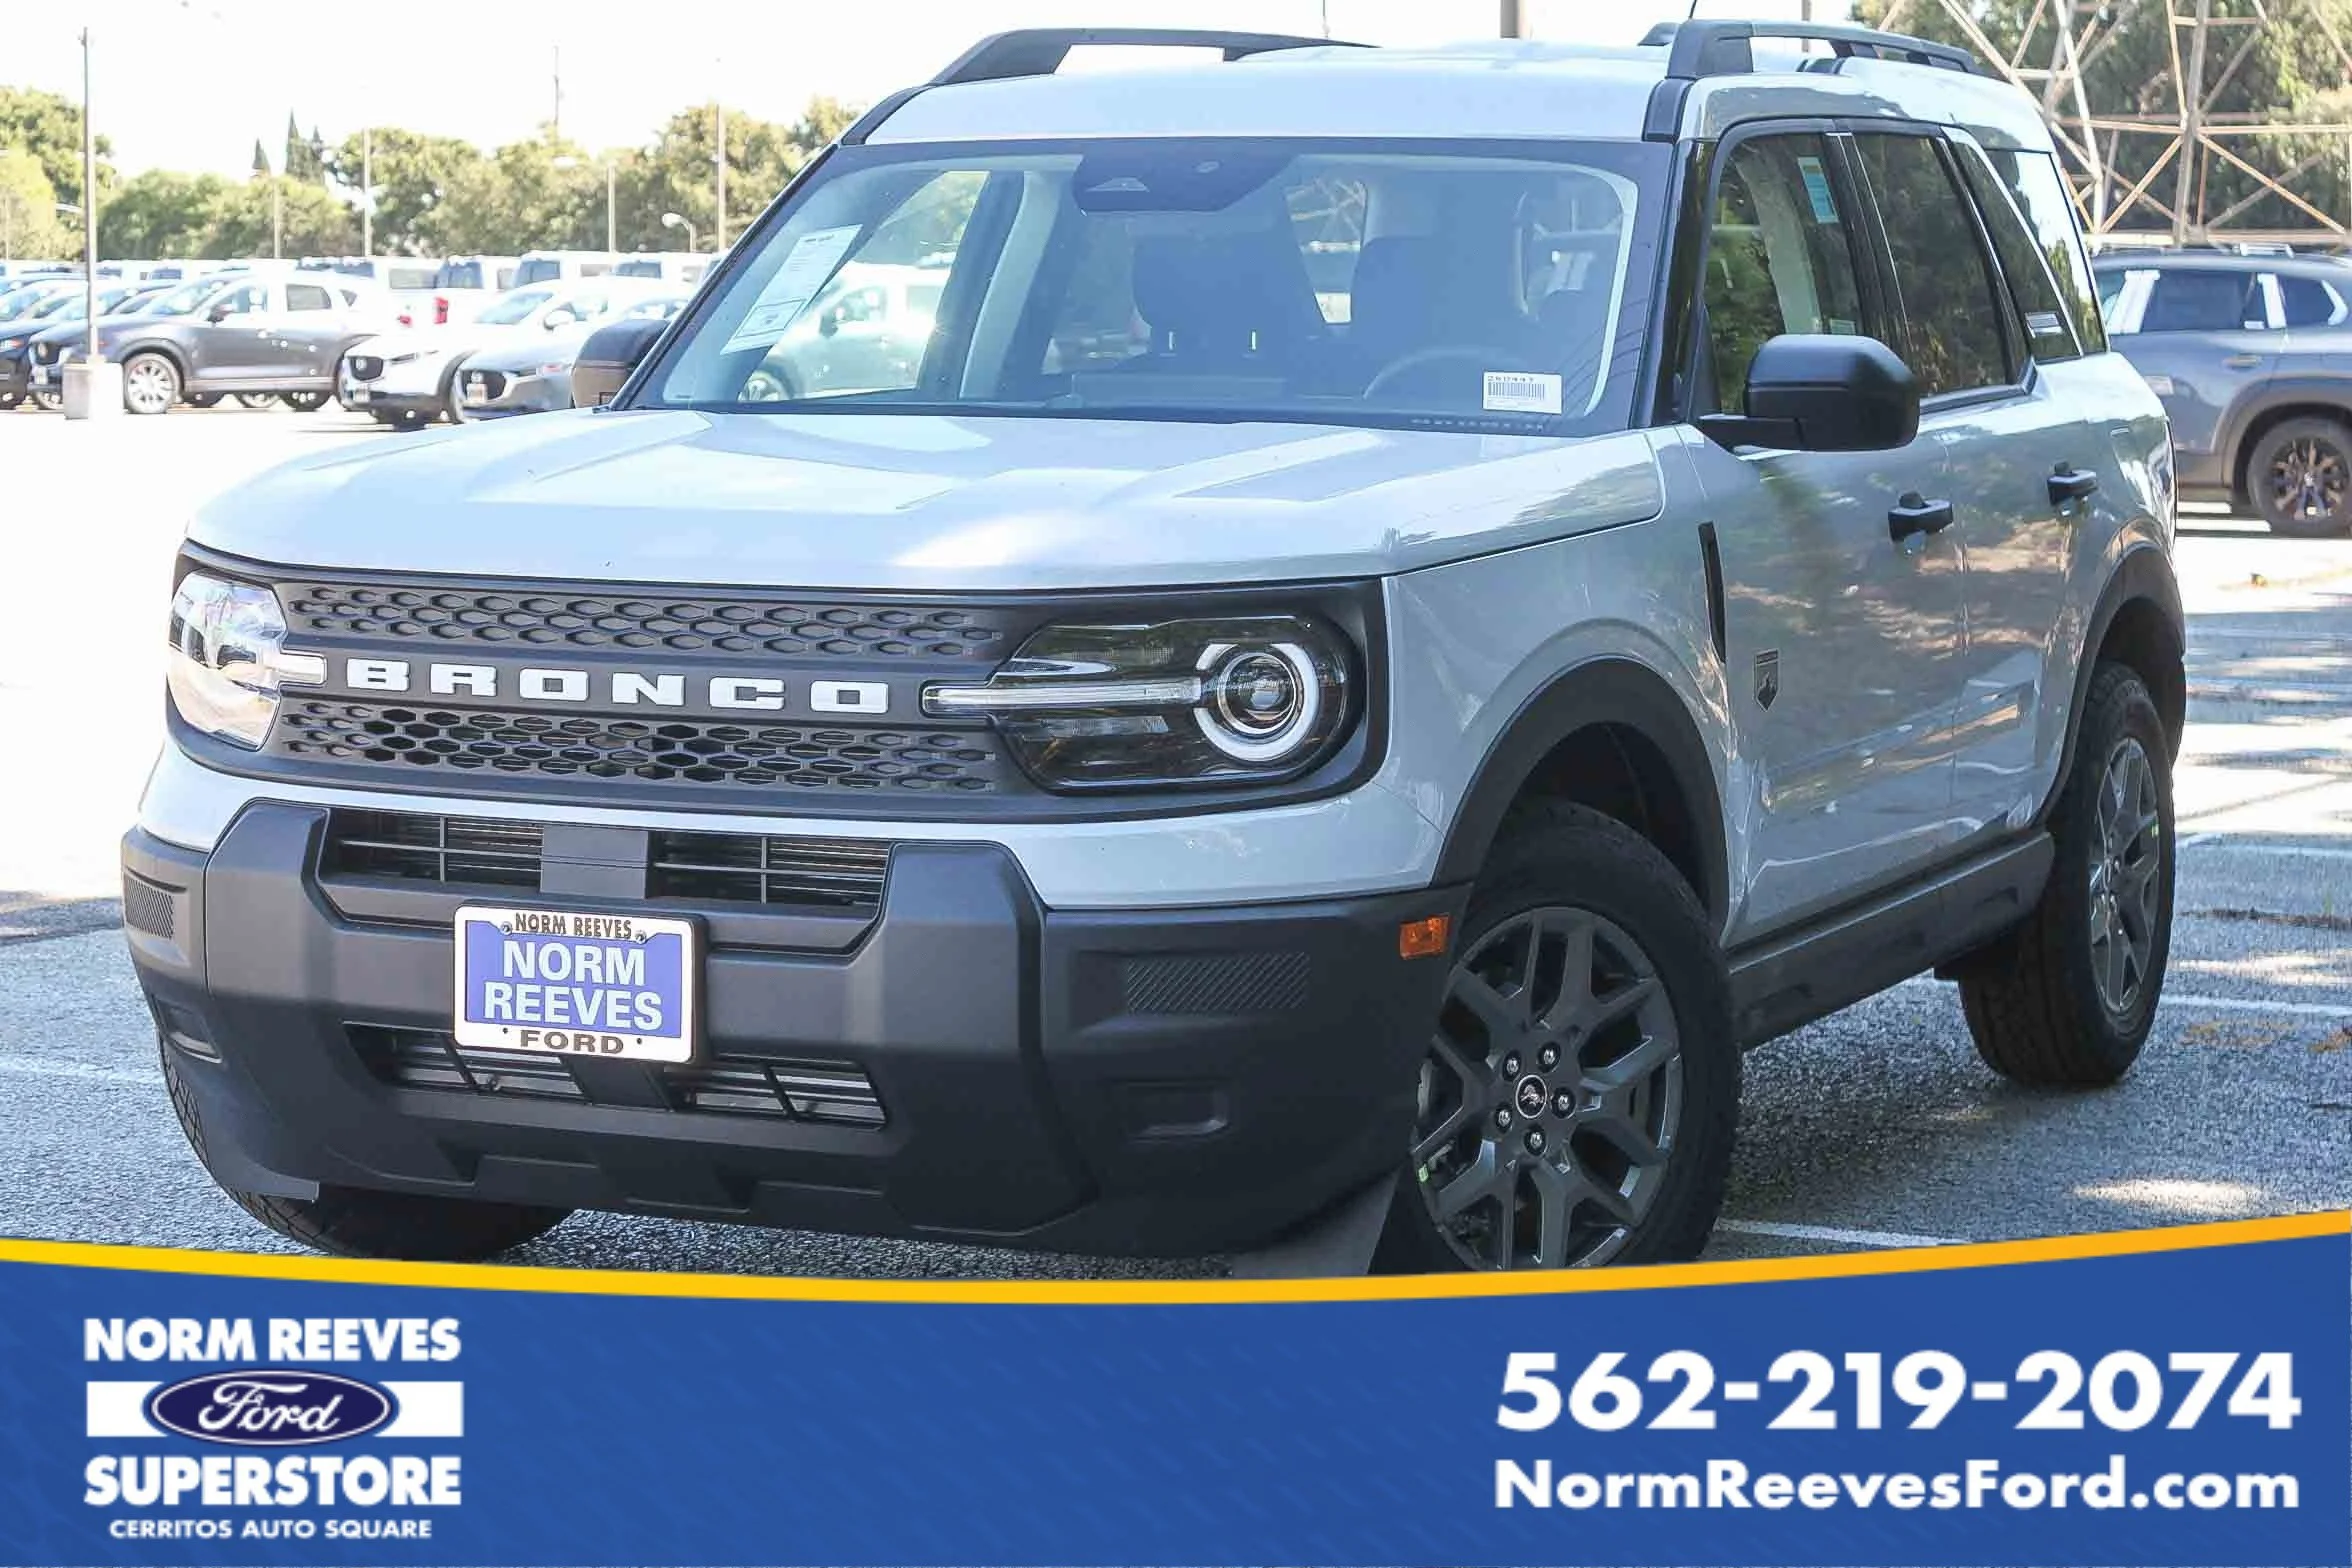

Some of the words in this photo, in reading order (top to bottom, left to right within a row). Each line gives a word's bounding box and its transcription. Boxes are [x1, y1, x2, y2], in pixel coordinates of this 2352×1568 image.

[346, 658, 889, 714] BRONCO
[515, 912, 567, 935] NORM
[573, 917, 632, 940] REEVES
[503, 940, 646, 987] NORM
[484, 981, 663, 1031] REEVES
[520, 1029, 624, 1055] FORD
